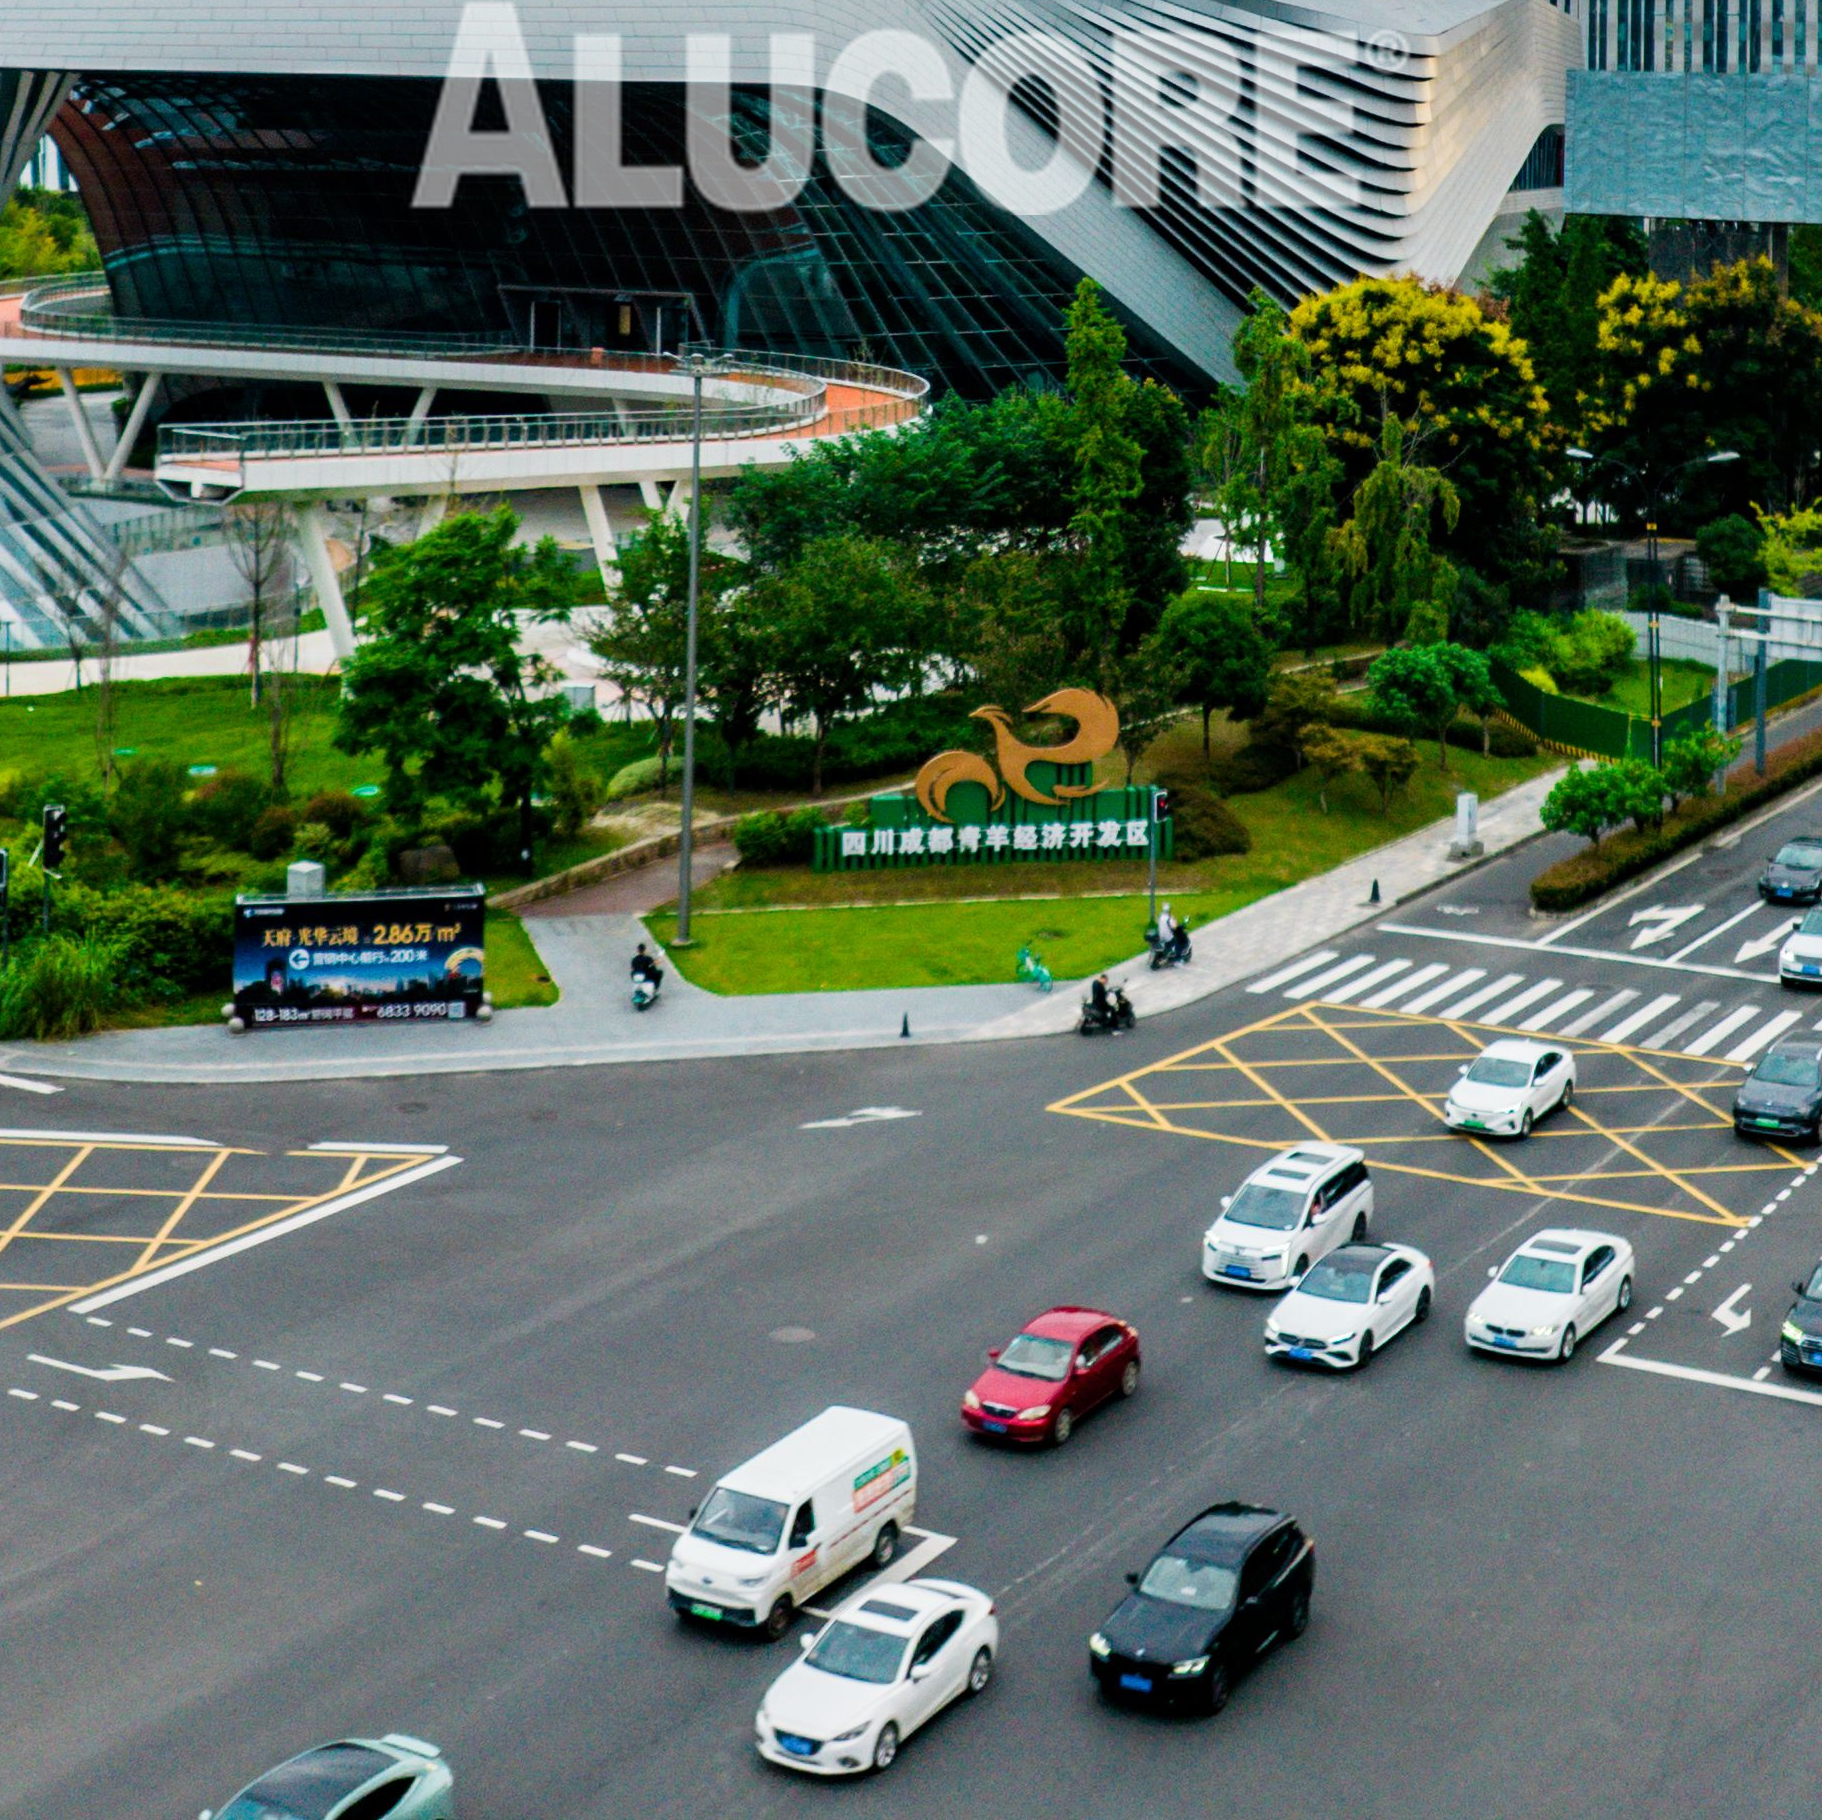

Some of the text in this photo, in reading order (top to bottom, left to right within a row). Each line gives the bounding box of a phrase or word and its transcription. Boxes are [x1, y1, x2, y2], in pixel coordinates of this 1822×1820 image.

[842, 821, 1150, 857] 四川成都青羊经济开发区
